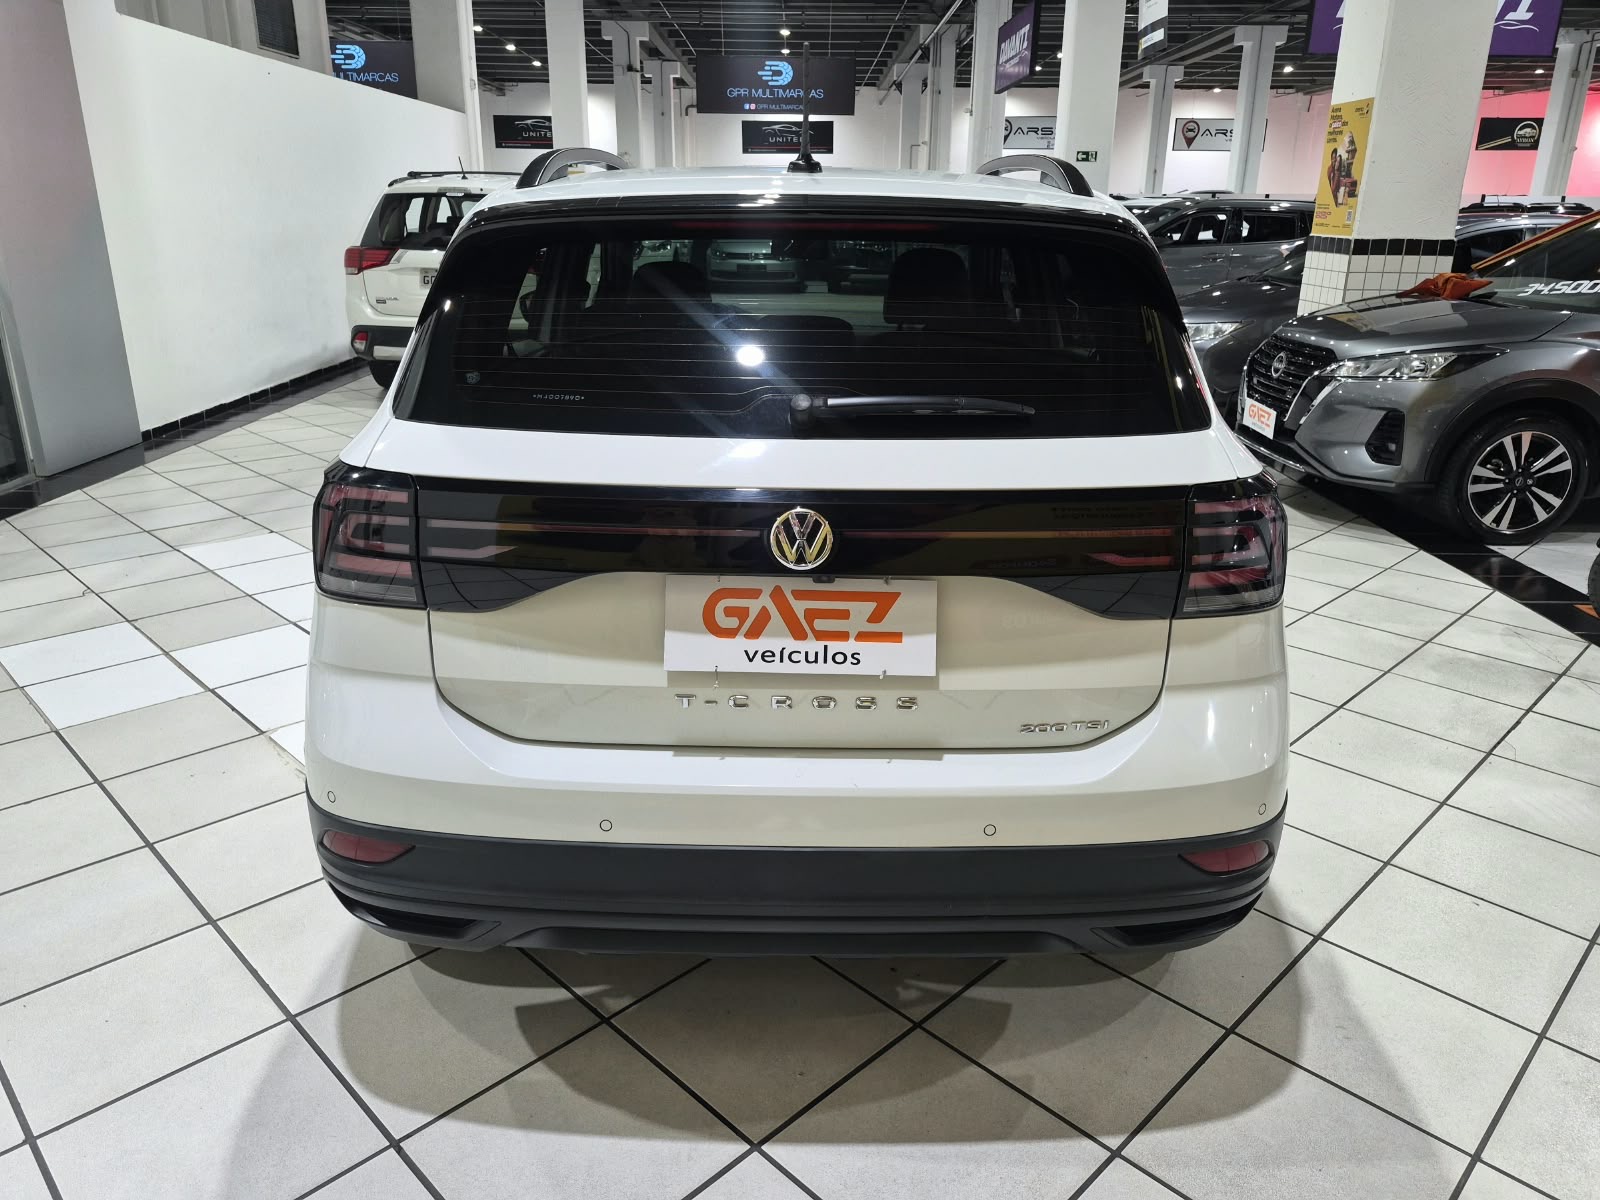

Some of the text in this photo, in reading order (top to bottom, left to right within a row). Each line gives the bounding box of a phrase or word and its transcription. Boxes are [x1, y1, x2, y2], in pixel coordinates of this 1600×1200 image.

[331, 71, 399, 83] ULTIMARCAS
[726, 87, 824, 98] GPR MULTIMARAS
[1013, 126, 1056, 136] ARS
[1516, 280, 1600, 297] 34.500
[775, 511, 829, 567] VW
[702, 585, 903, 642] GAEZ
[743, 644, 862, 667] veículos
[674, 692, 919, 711] T-CROSS
[1020, 720, 1110, 734] 200 TSI
